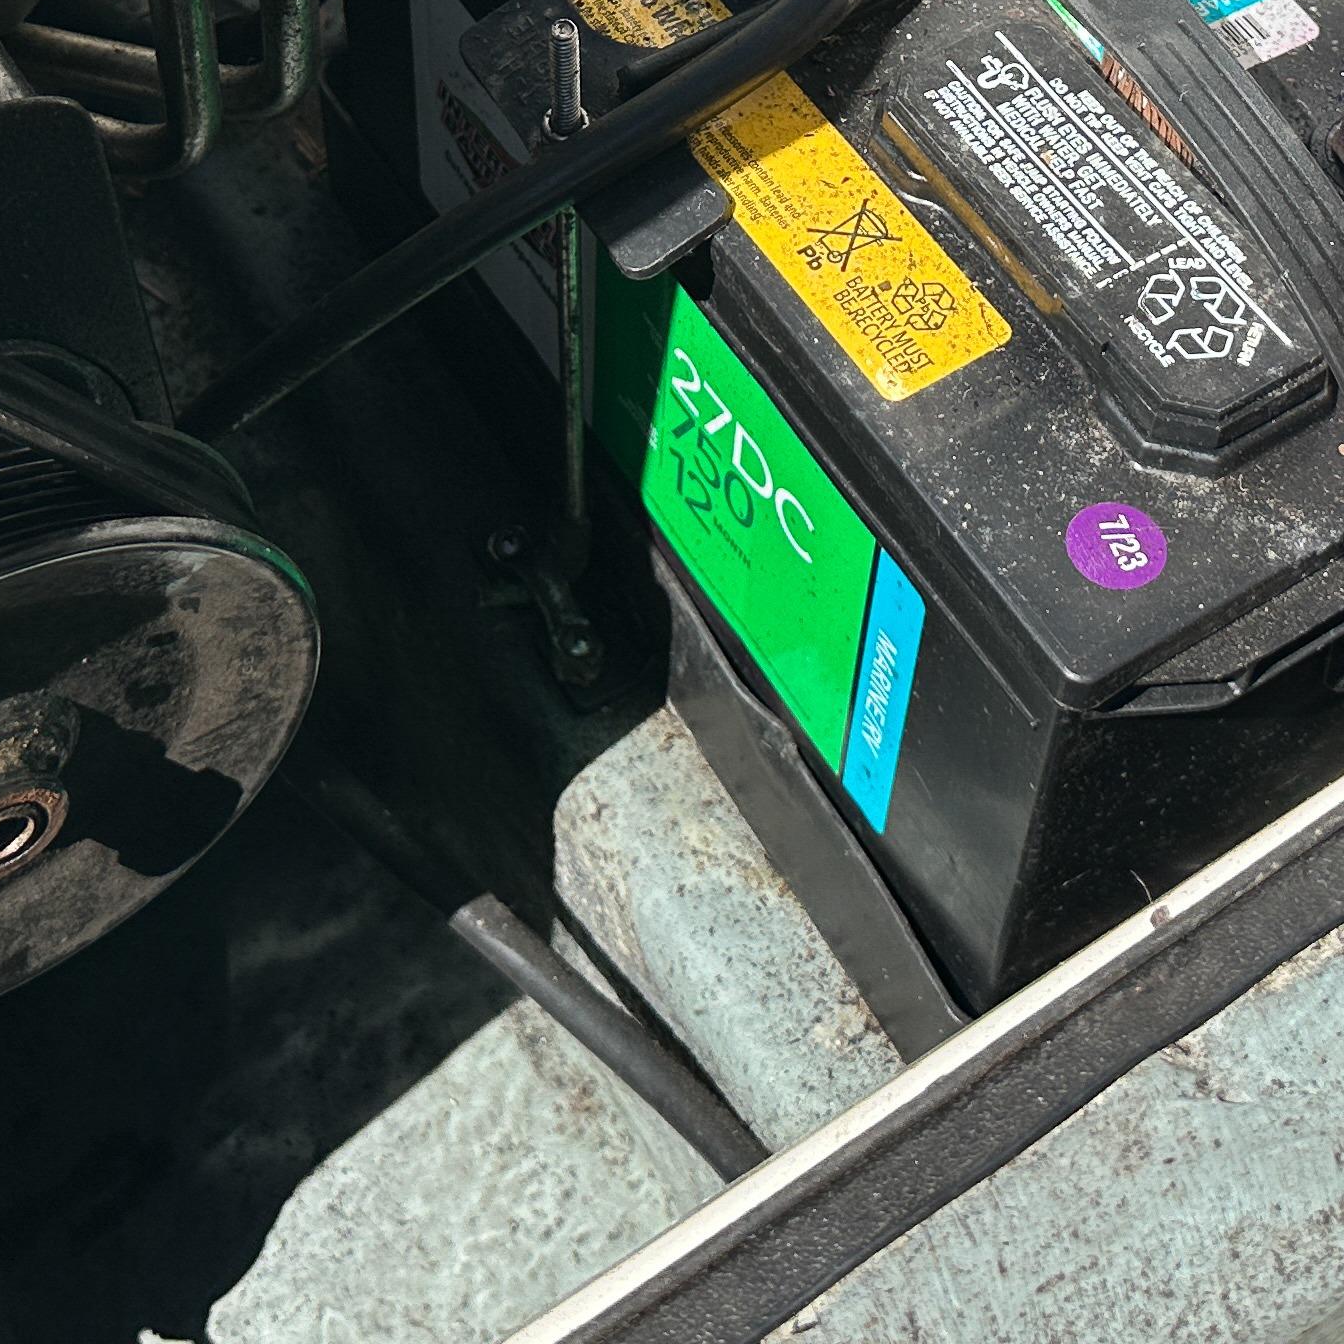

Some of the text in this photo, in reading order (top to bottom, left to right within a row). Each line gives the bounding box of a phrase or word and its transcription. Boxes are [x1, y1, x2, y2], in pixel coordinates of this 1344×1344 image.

[745, 158, 777, 187] contain
[767, 184, 791, 204] lead
[782, 201, 804, 219] and
[922, 89, 938, 102] IF
[931, 99, 957, 121] NOT
[947, 118, 995, 164] AVAILABLE
[986, 161, 1017, 188] SEEK
[1007, 184, 1049, 223] SERVICE
[933, 85, 997, 148] INSTRUCTIONS
[989, 145, 1006, 159] IN
[998, 156, 1040, 195] VEHICLE
[1030, 191, 1074, 232] OWNERS
[980, 117, 1006, 139] FOR
[997, 136, 1027, 162] SAFE
[1018, 159, 1050, 187] JUMP
[1040, 184, 1089, 230] STARTING
[1079, 226, 1122, 266] FOLLOW
[993, 101, 1104, 212] MEDICAL HELP FAST
[1007, 93, 1044, 124] WITH
[1074, 164, 1107, 191] GET
[1022, 85, 1163, 229] FLUSH EYES IMMEDIATELY
[1046, 76, 1071, 96] DO
[1060, 92, 1088, 115] NOT
[1098, 130, 1130, 158] KEEP
[1122, 154, 1154, 183] VENT
[1145, 179, 1178, 209] CAPS
[1171, 206, 1206, 237] TIGHT
[1198, 235, 1227, 261] AND
[1074, 88, 1248, 265] KEEP OUT OF THE REACH OF CHILDREN
[795, 244, 827, 271] Pb
[913, 297, 932, 313] Pb
[1168, 258, 1205, 268] LEAD
[831, 288, 915, 375] BE RECYCLED
[842, 275, 935, 371] BATTERY MUST
[669, 449, 751, 568] 12 MONTH
[670, 388, 753, 528] 750
[671, 347, 816, 565] 27DC
